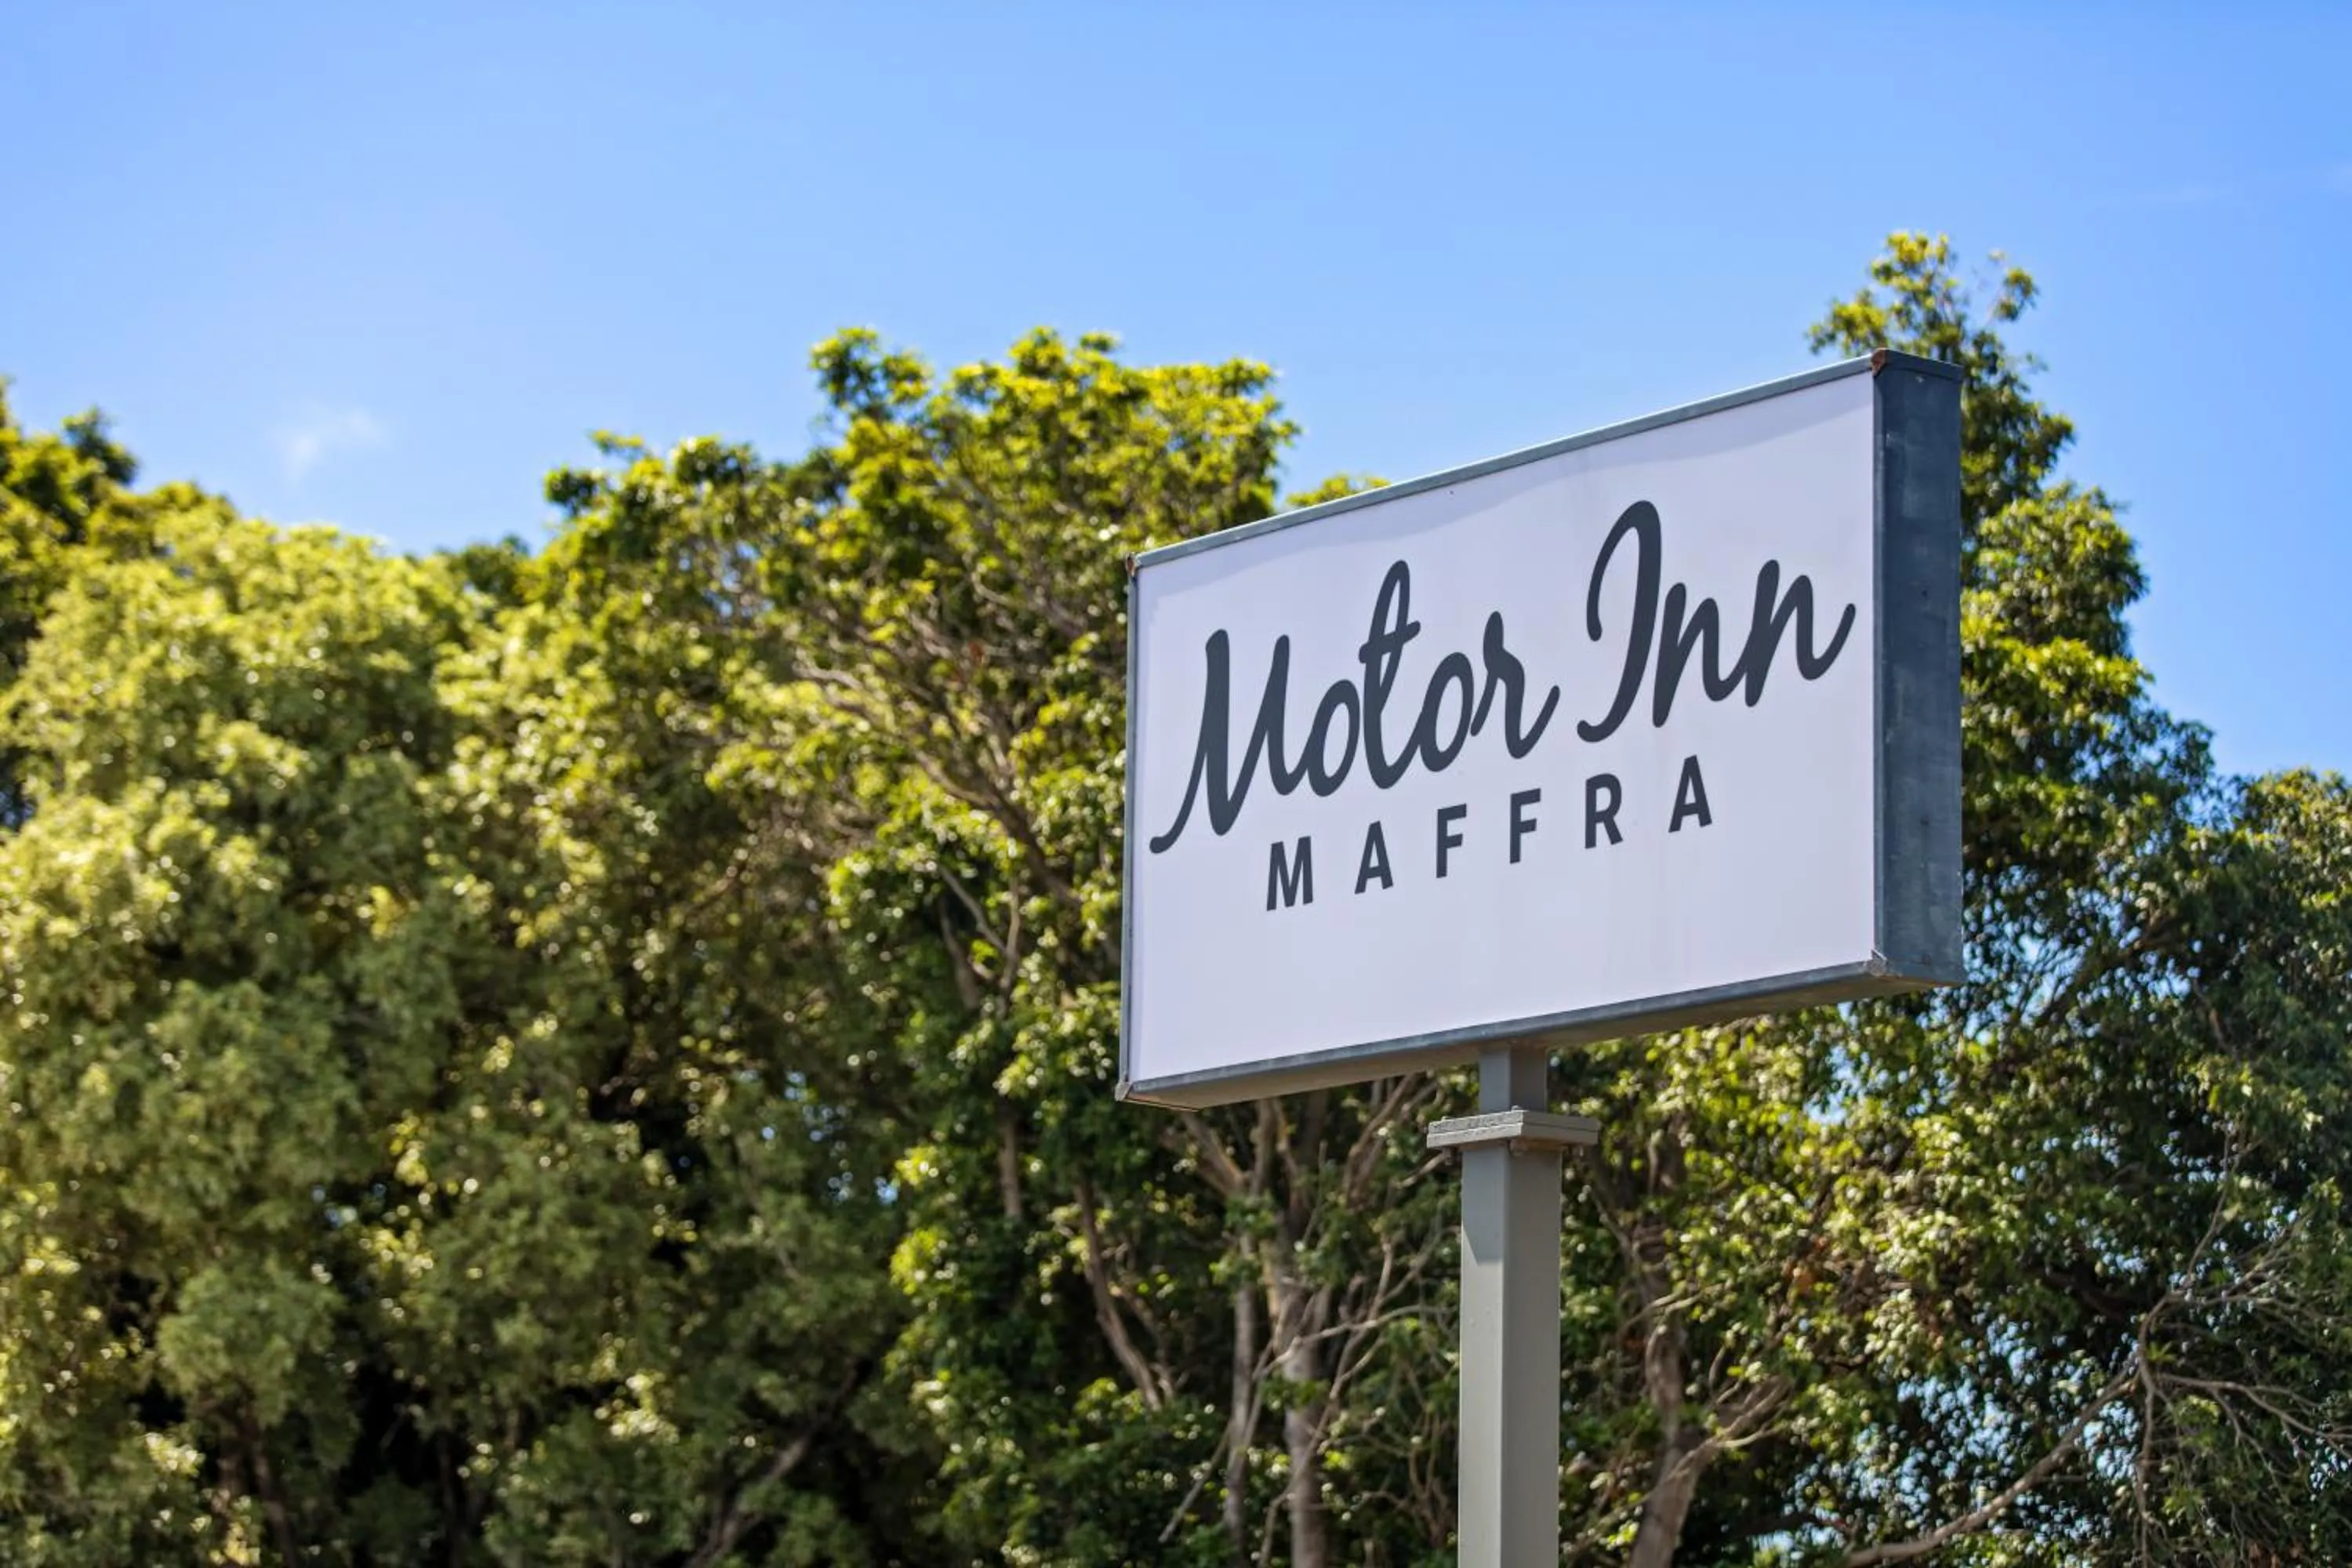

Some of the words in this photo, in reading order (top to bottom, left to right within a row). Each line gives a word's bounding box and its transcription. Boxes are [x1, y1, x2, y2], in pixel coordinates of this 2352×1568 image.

[1149, 560, 1561, 855] Motor
[1577, 499, 1857, 743] Inn
[1266, 754, 1713, 912] MAFFRA
